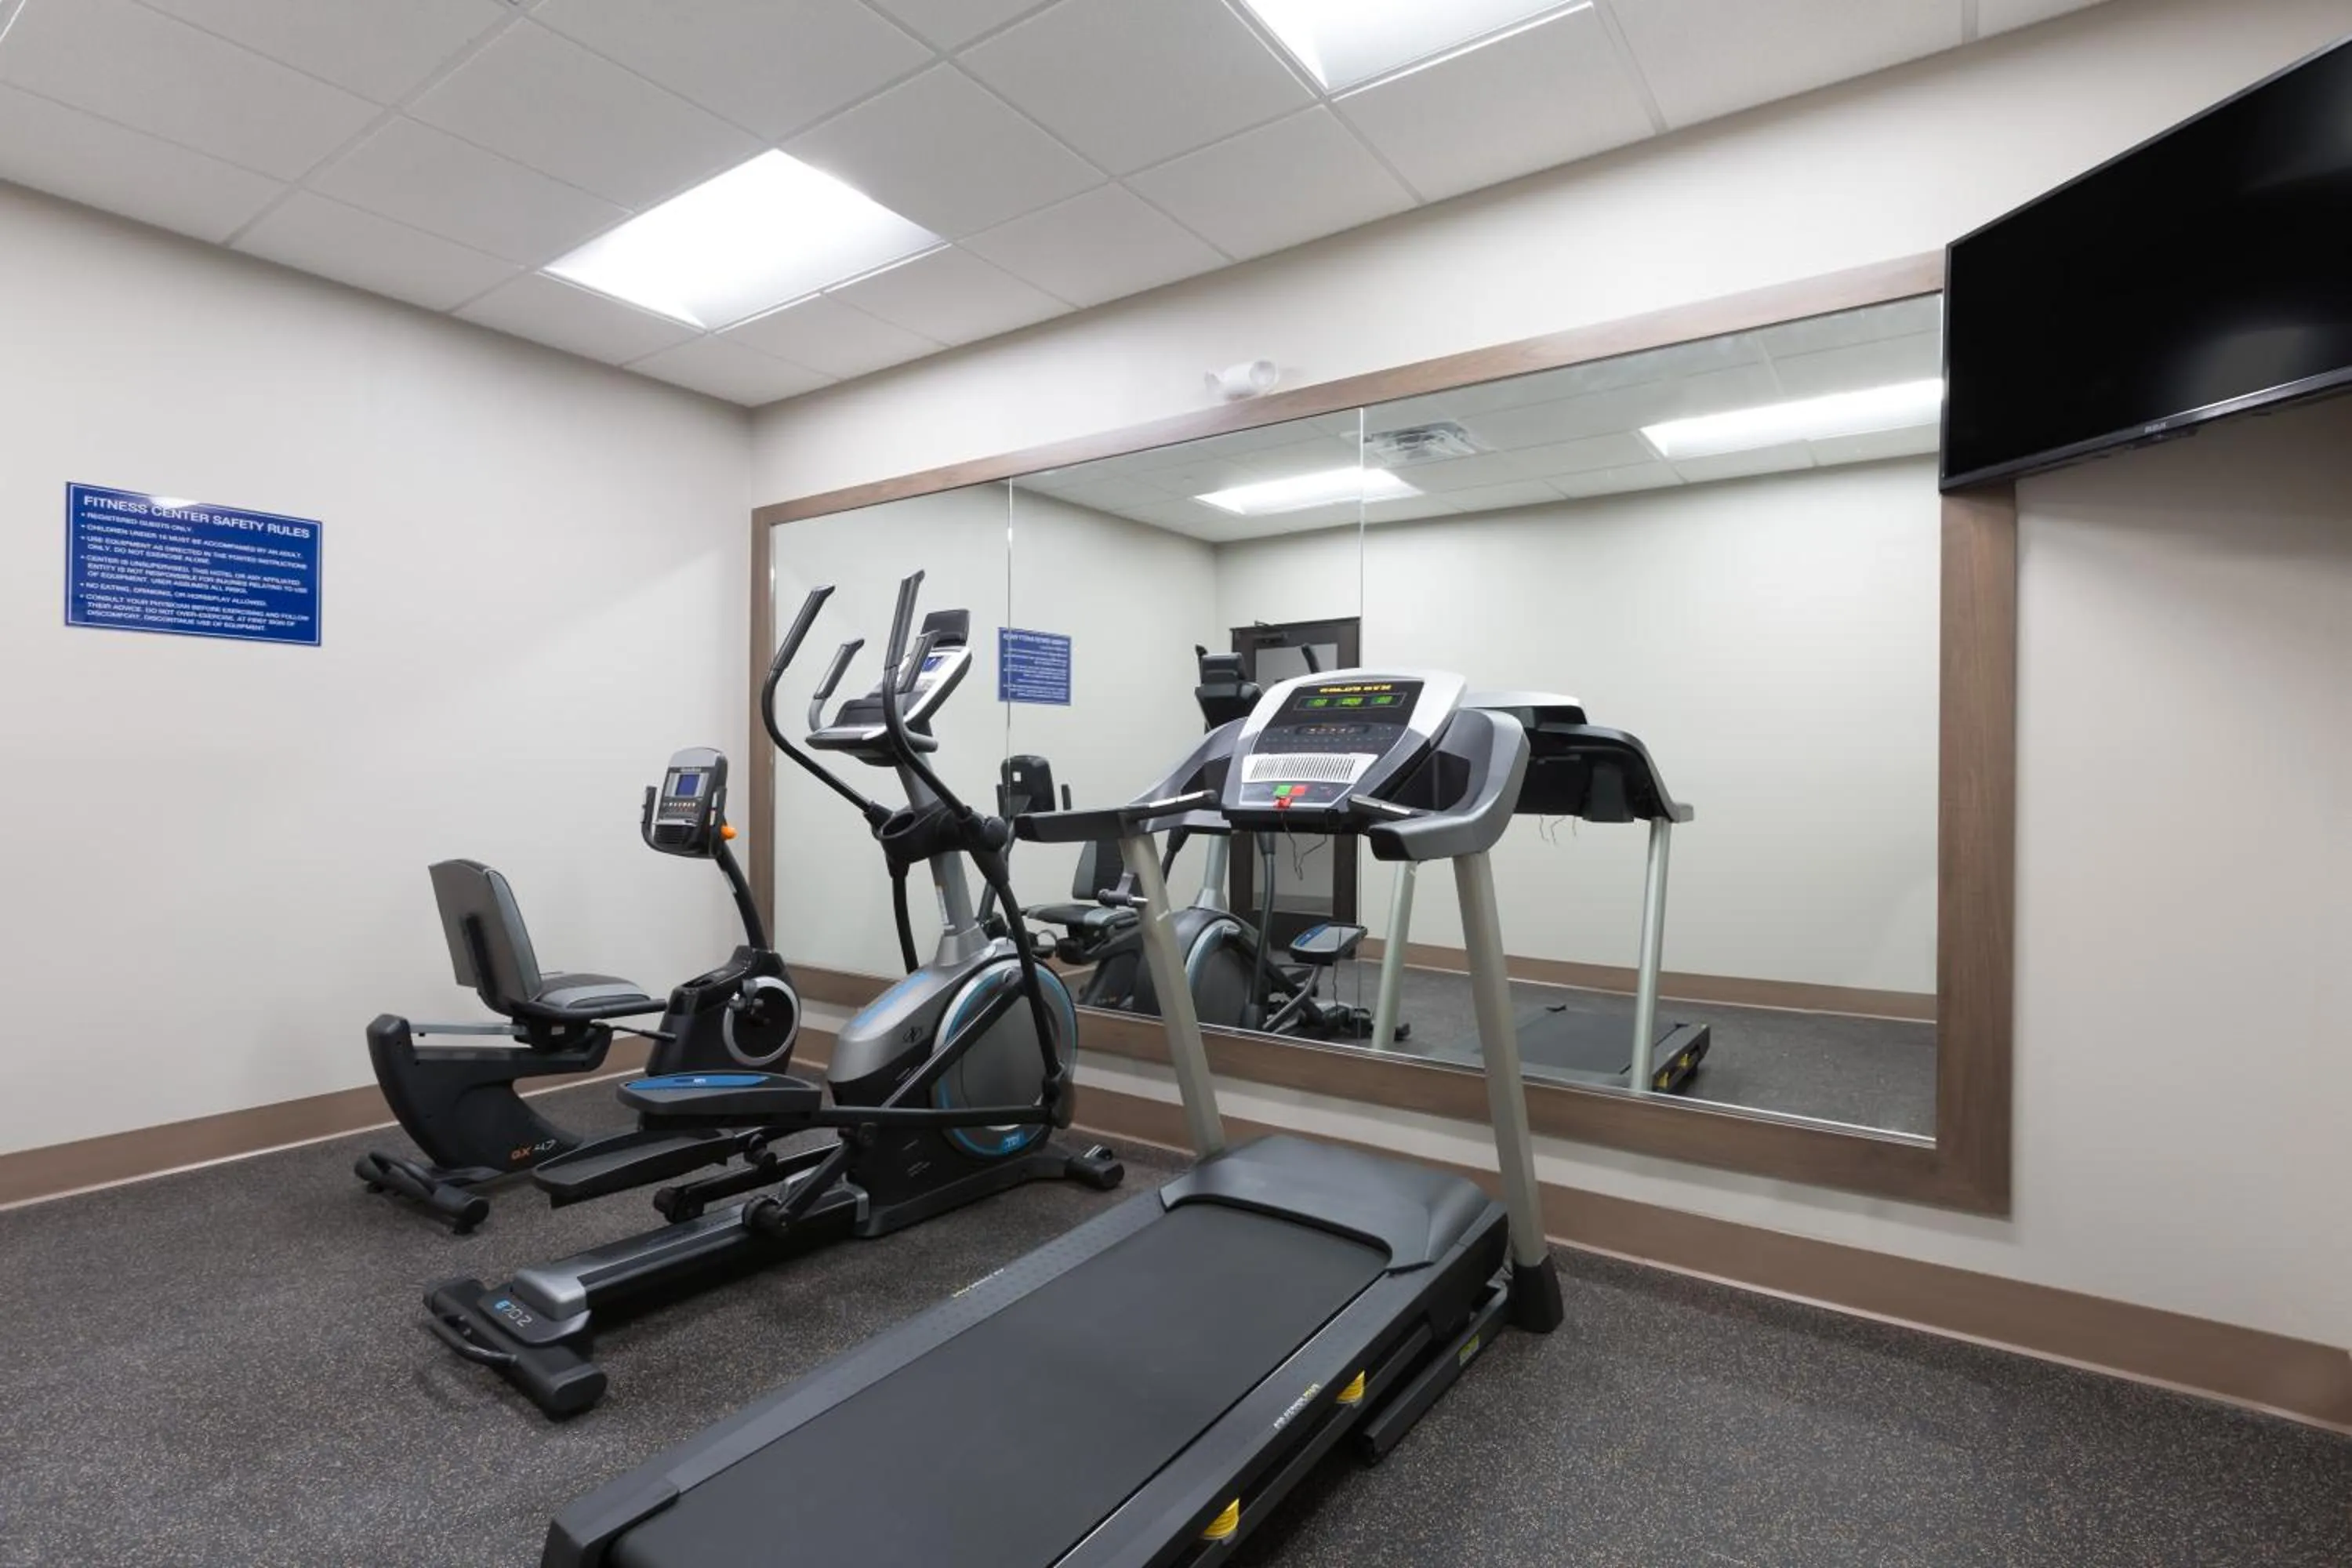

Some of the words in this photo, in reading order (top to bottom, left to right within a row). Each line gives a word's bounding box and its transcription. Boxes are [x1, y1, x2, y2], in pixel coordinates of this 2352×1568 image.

[84, 495, 147, 514] FITNESS
[151, 506, 209, 522] CENTER
[212, 515, 263, 531] SAFETY
[267, 524, 310, 537] RULES
[87, 512, 137, 524] REGISTERED
[140, 520, 169, 528] GUESTS
[87, 524, 127, 534] CHILDREN
[105, 538, 151, 549] EQUIPMENT
